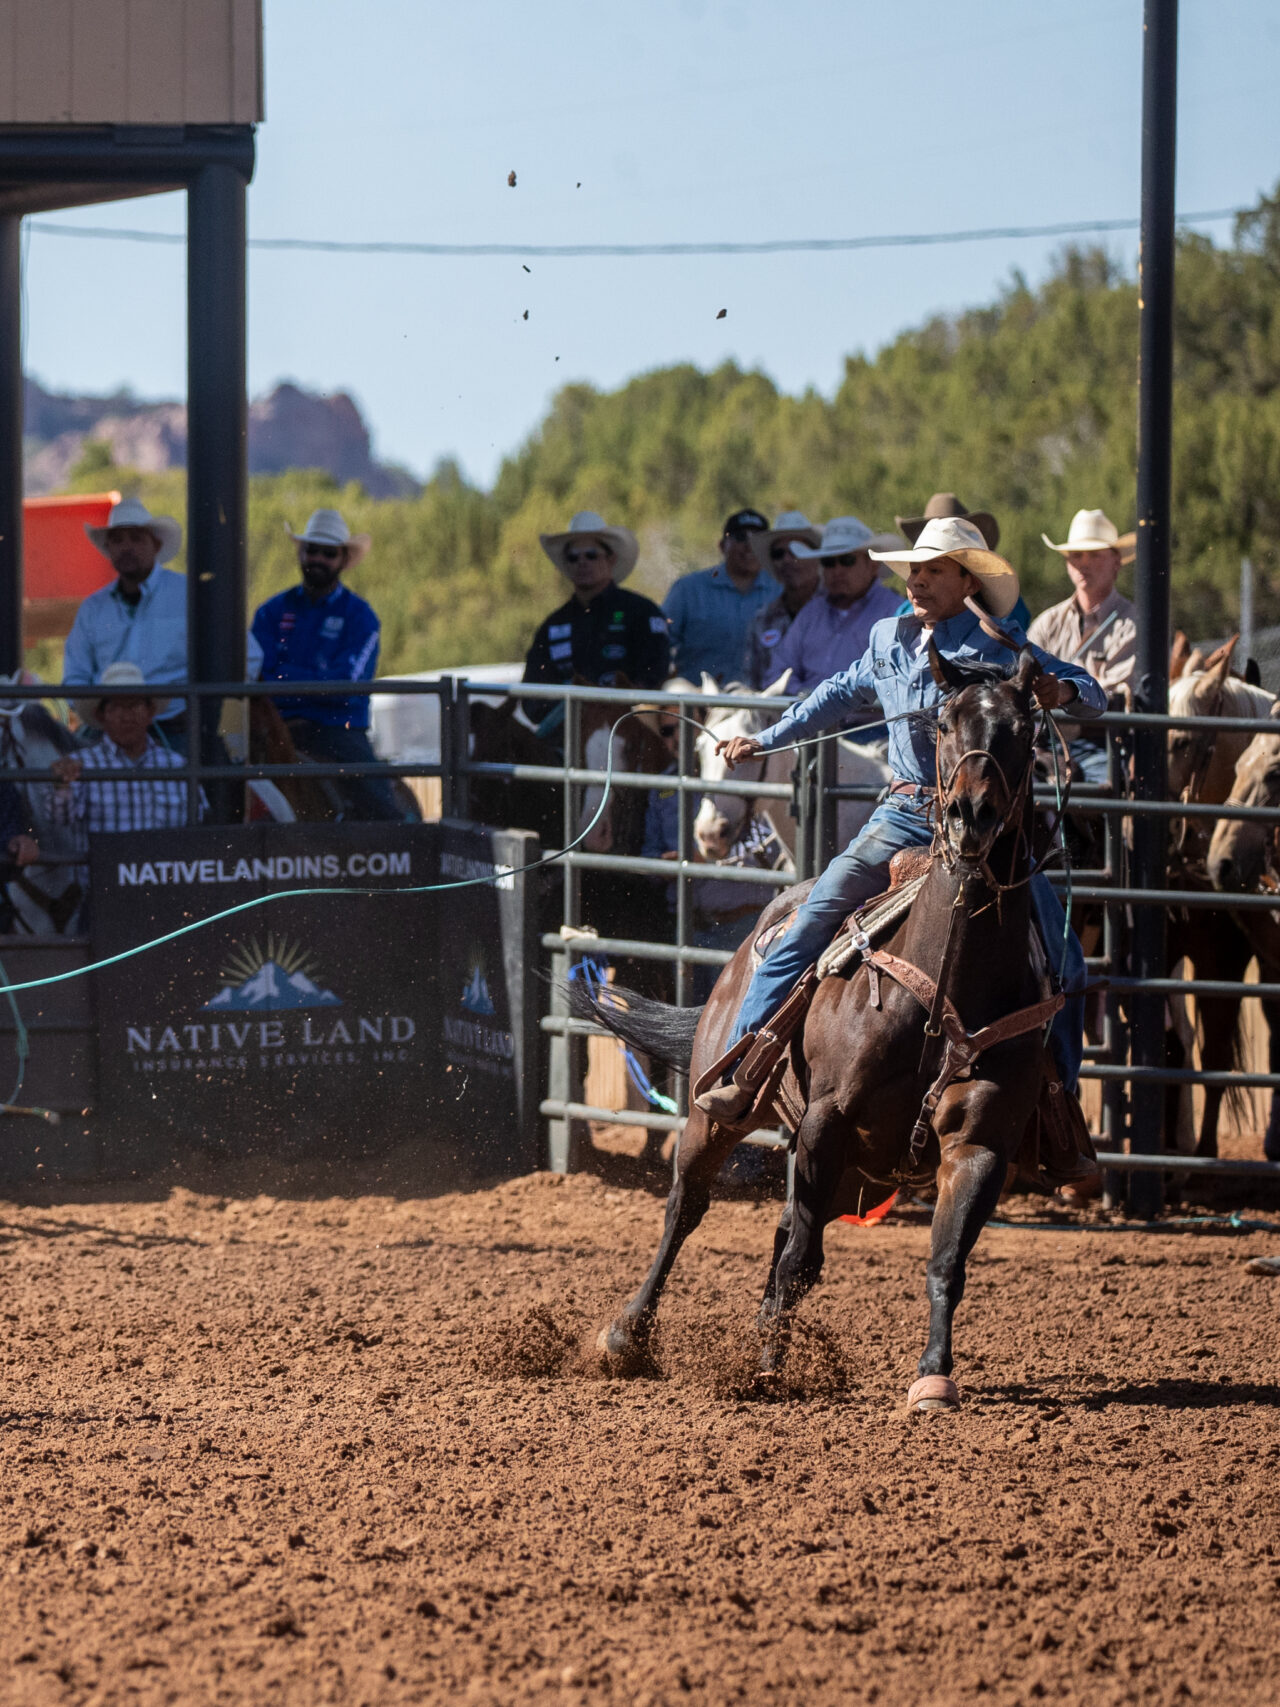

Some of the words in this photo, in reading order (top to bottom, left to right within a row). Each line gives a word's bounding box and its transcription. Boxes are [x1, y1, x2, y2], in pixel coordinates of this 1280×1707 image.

[118, 852, 411, 886] NATIVELANDINS.COM
[126, 1020, 286, 1052] NATIVE
[302, 1015, 417, 1046] LAND
